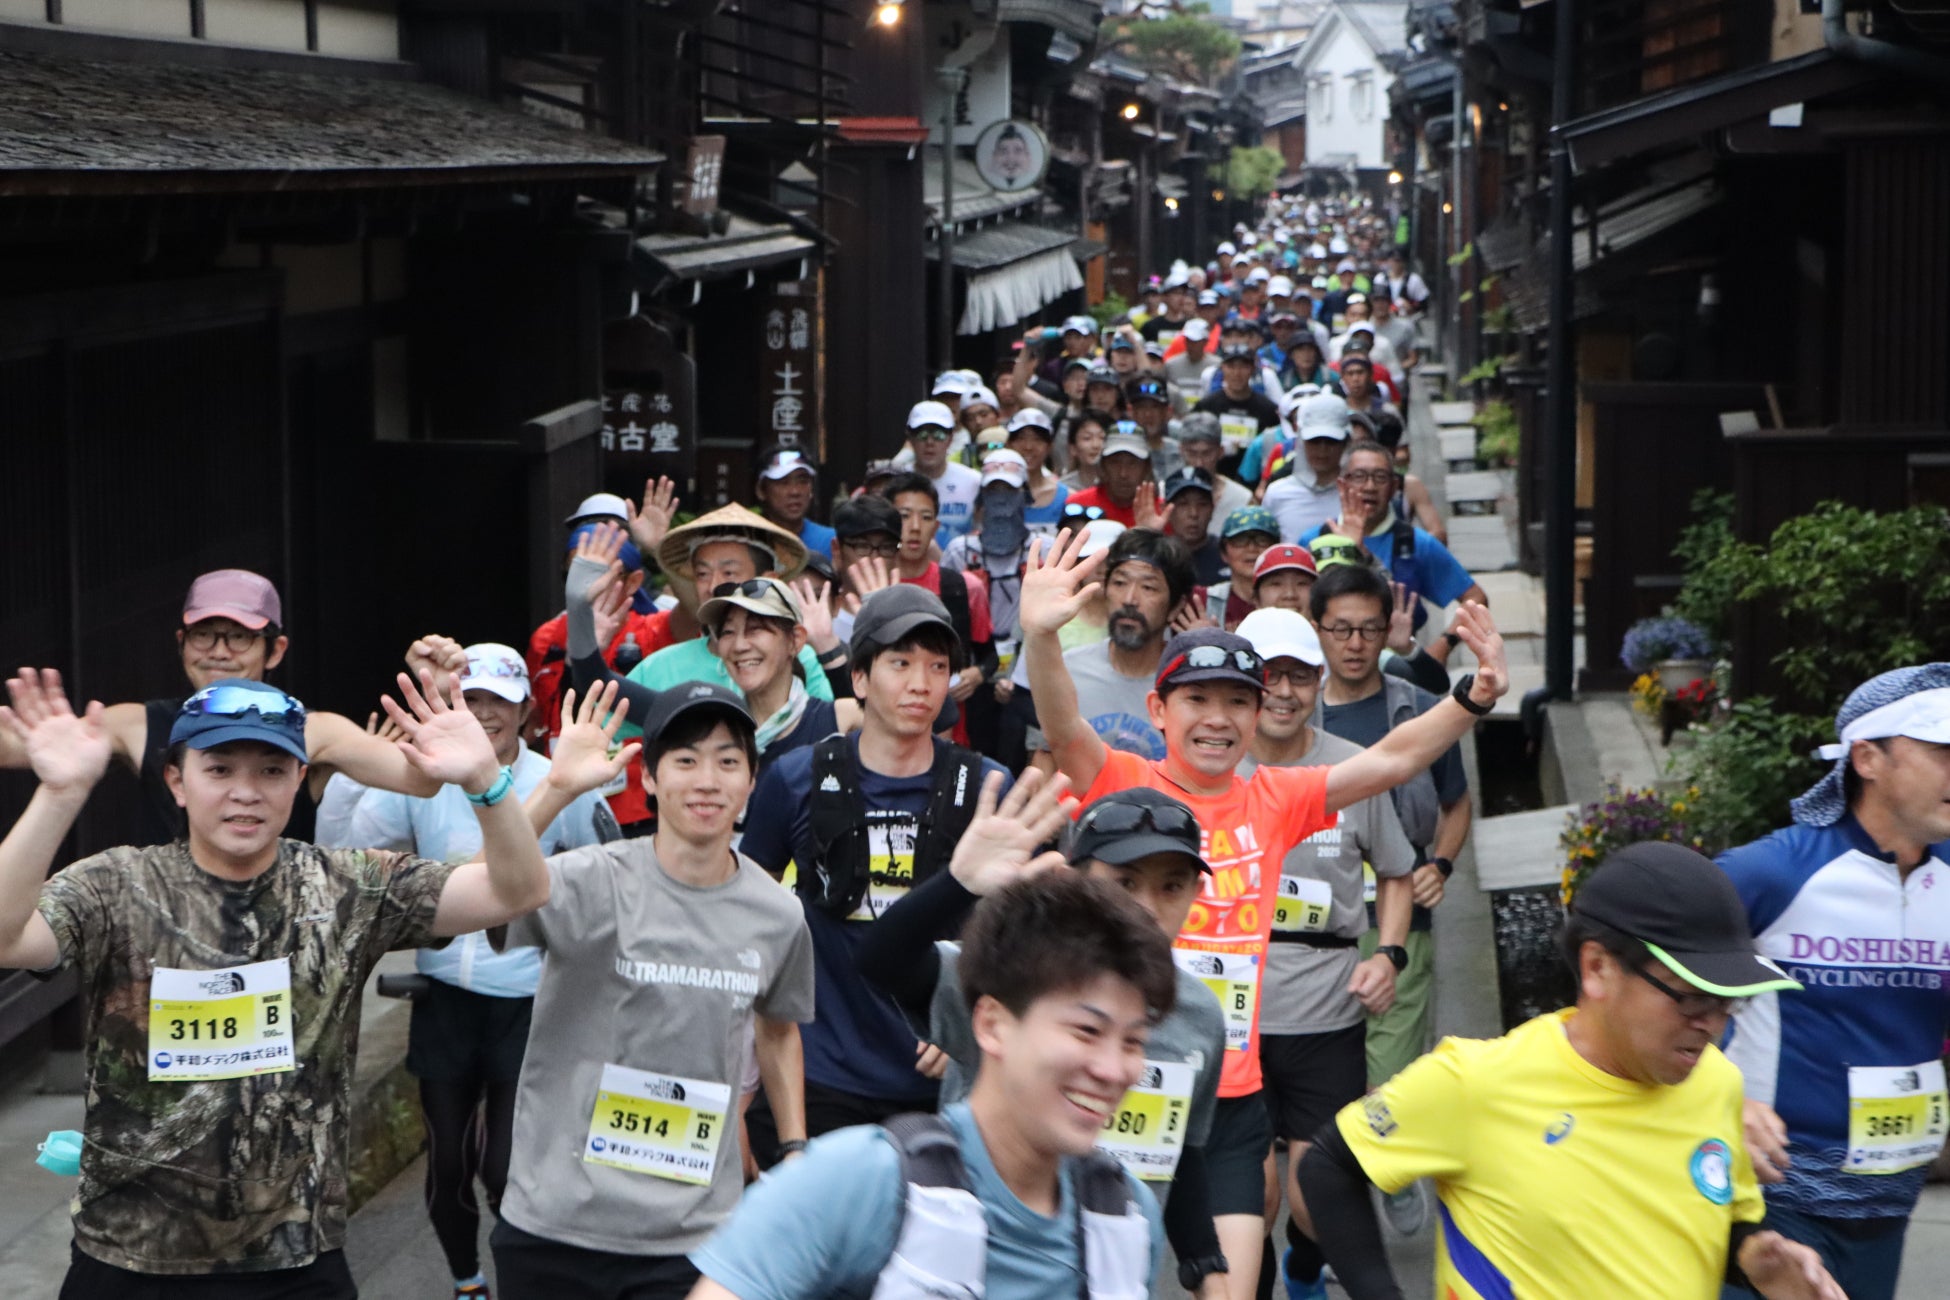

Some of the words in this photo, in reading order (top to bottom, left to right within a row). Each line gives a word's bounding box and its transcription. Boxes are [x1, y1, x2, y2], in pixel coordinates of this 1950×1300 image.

[1309, 912, 1319, 925] B
[615, 956, 759, 994] ULTRAMARATHON
[1789, 966, 1885, 988] CYCLING
[1887, 970, 1942, 990] CLUB
[1235, 993, 1245, 1010] B
[266, 1005, 279, 1025] B
[170, 1016, 238, 1040] 3118
[609, 1110, 669, 1138] 3514
[696, 1122, 711, 1140] B
[1867, 1114, 1914, 1137] 3661
